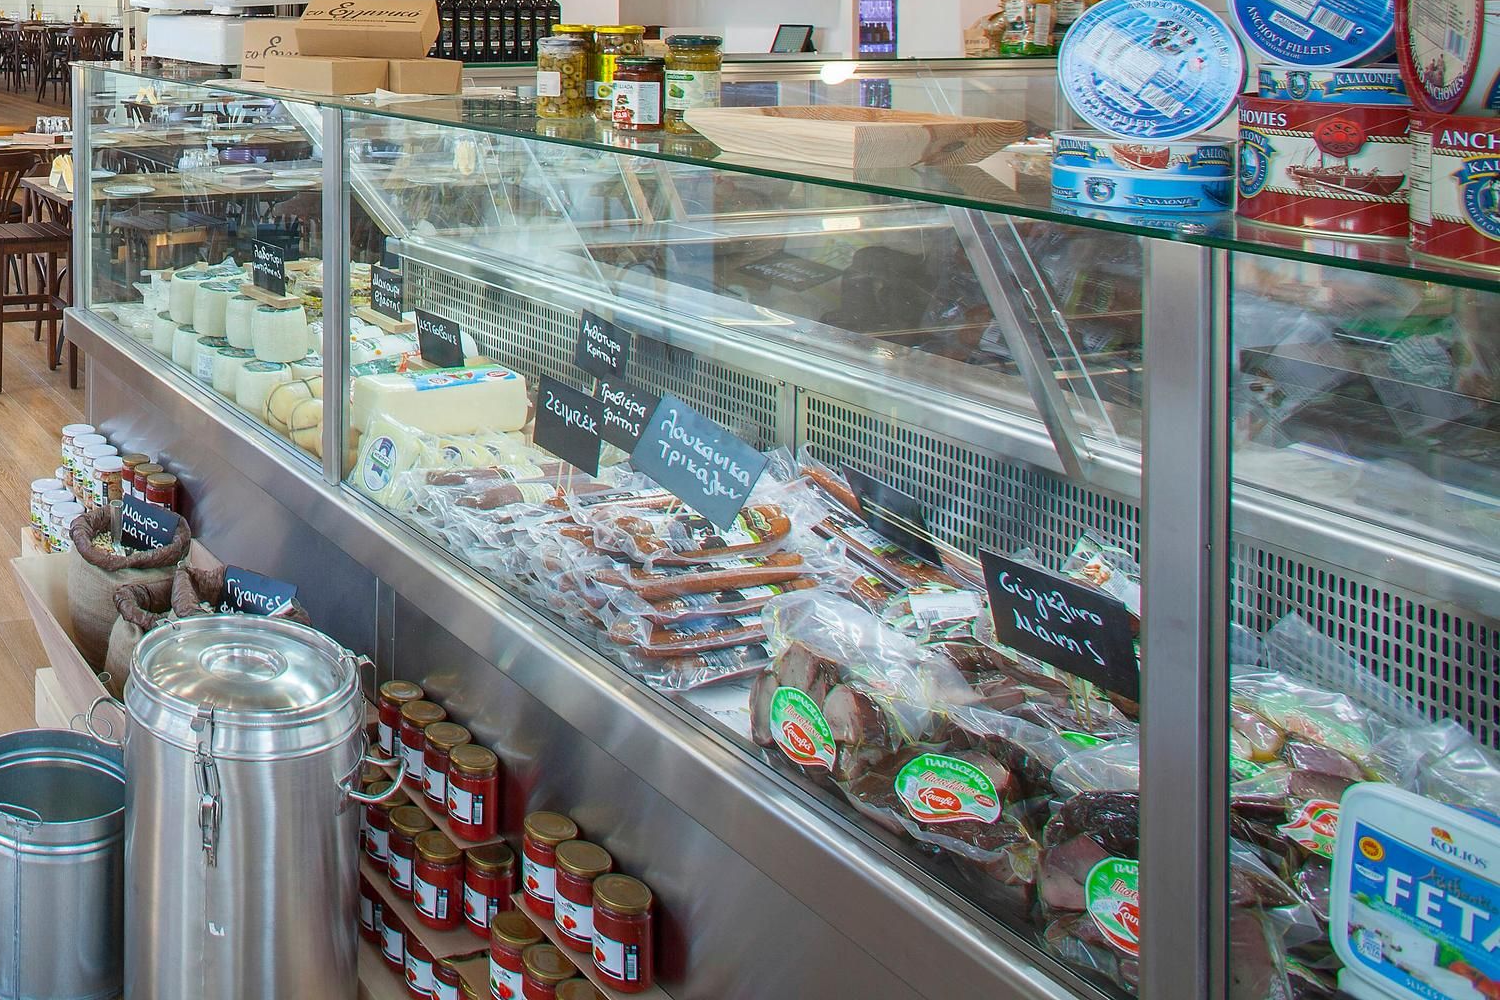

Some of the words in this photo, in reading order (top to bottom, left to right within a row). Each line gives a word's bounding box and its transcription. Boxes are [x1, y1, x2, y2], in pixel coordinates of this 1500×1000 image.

[1246, 5, 1286, 47] ANCHOVY
[1286, 42, 1332, 55] FILLETS
[1336, 72, 1394, 86] ΚΑΛΛΟΝΗ
[1424, 77, 1465, 101] ANCHOVIES
[1430, 835, 1489, 870] KOLIOS
